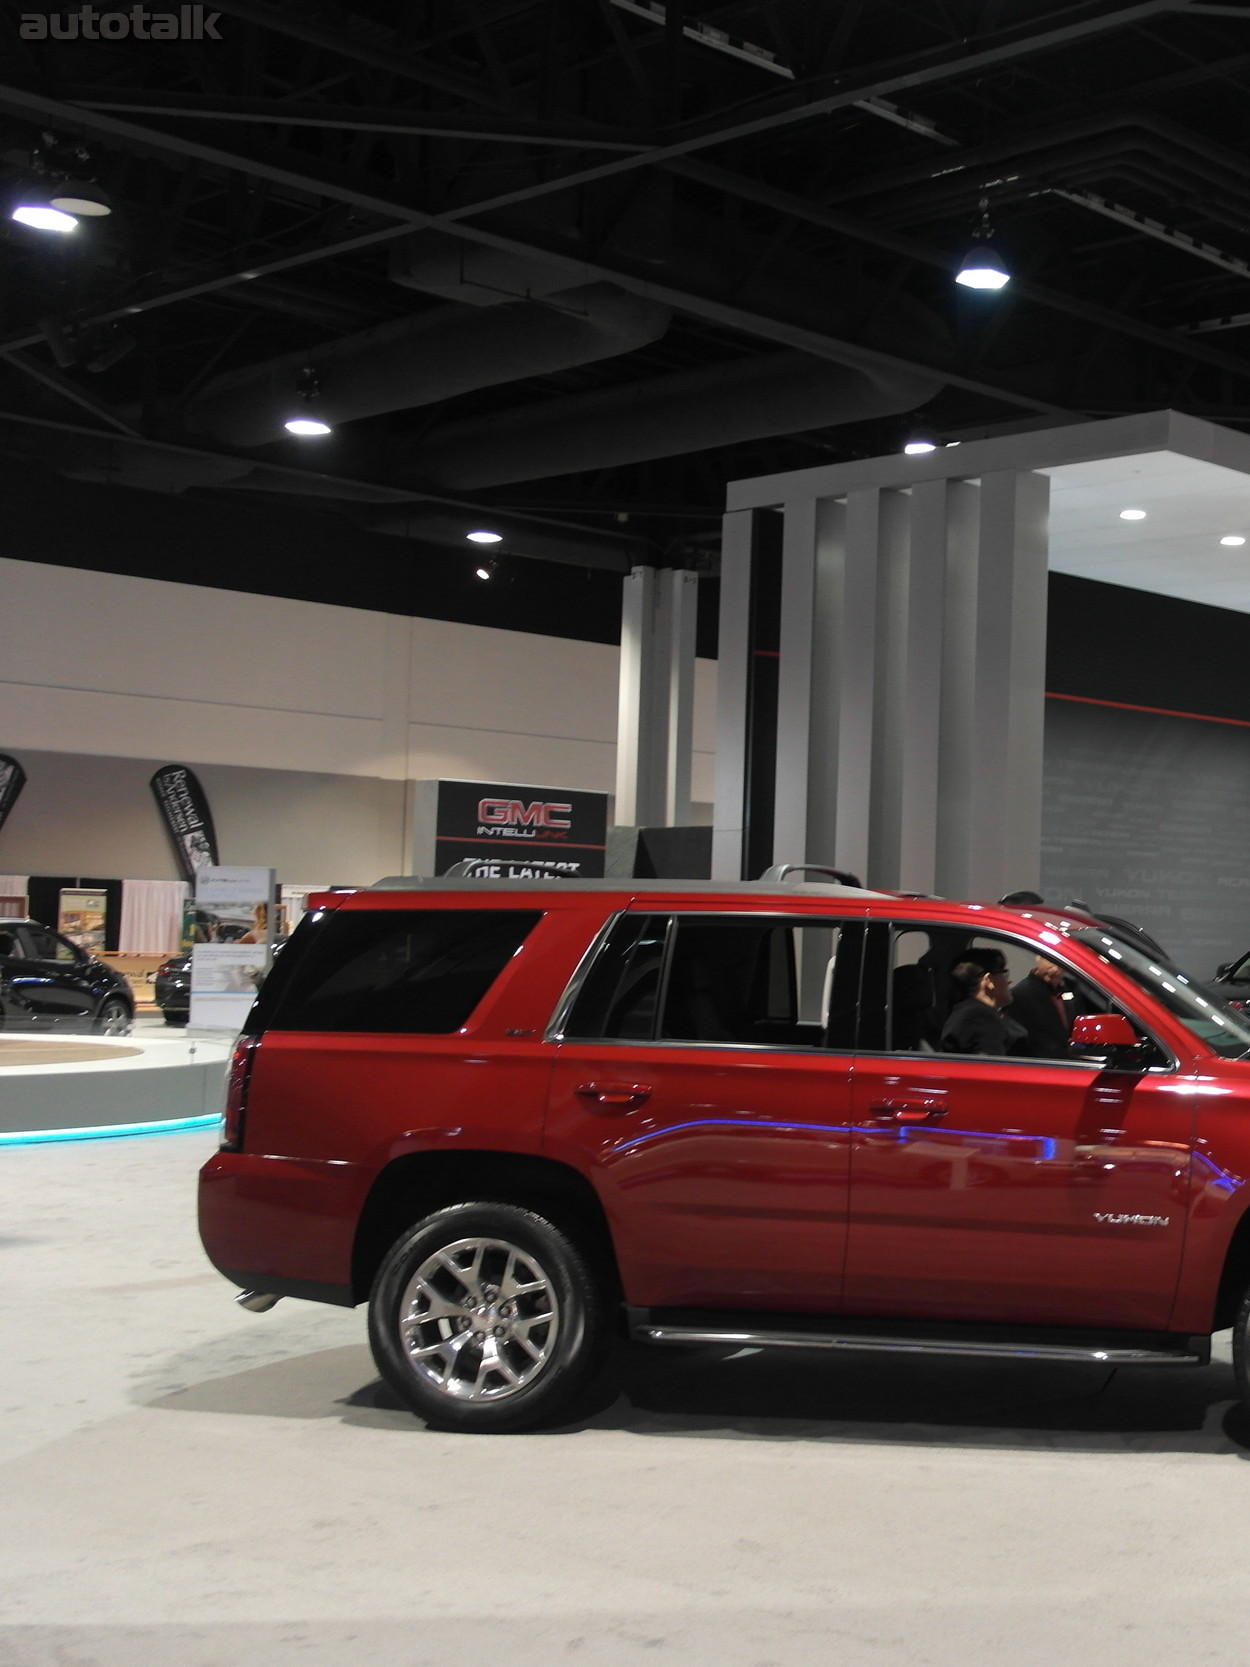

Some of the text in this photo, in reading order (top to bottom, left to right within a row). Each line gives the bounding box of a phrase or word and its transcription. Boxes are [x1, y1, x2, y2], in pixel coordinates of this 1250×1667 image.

[172, 769, 204, 829] Renewal
[478, 798, 572, 829] GMC
[1093, 1212, 1170, 1227] YUKON
